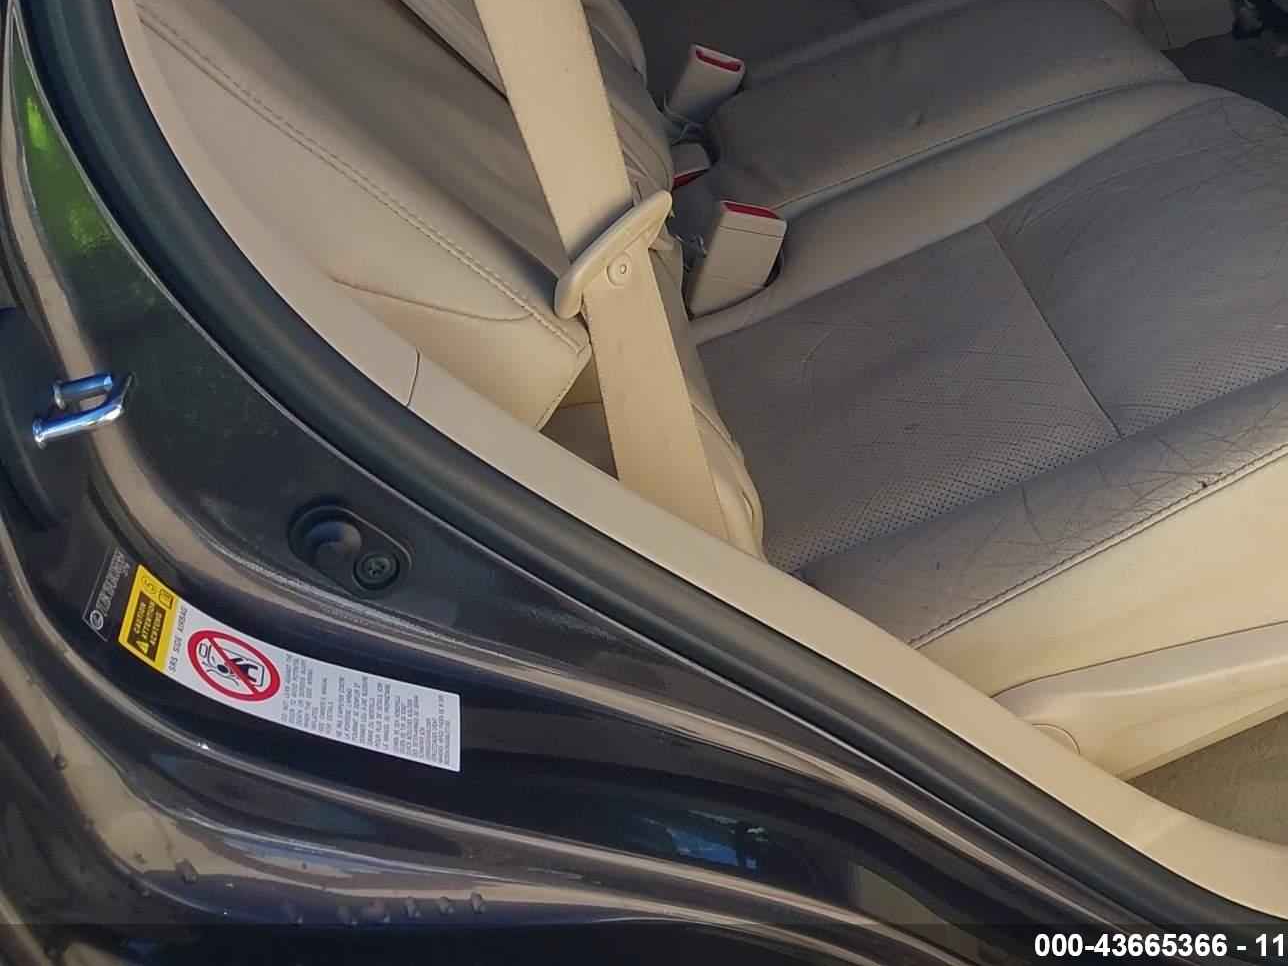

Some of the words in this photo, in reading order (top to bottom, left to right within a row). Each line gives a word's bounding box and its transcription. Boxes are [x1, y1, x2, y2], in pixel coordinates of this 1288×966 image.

[133, 601, 146, 634] CAUTION
[141, 600, 155, 640] ATTENTION
[149, 611, 162, 646] ACHTUNG
[179, 605, 188, 633] AIRBAG
[172, 635, 182, 653] SIDE
[168, 656, 178, 672] SRS
